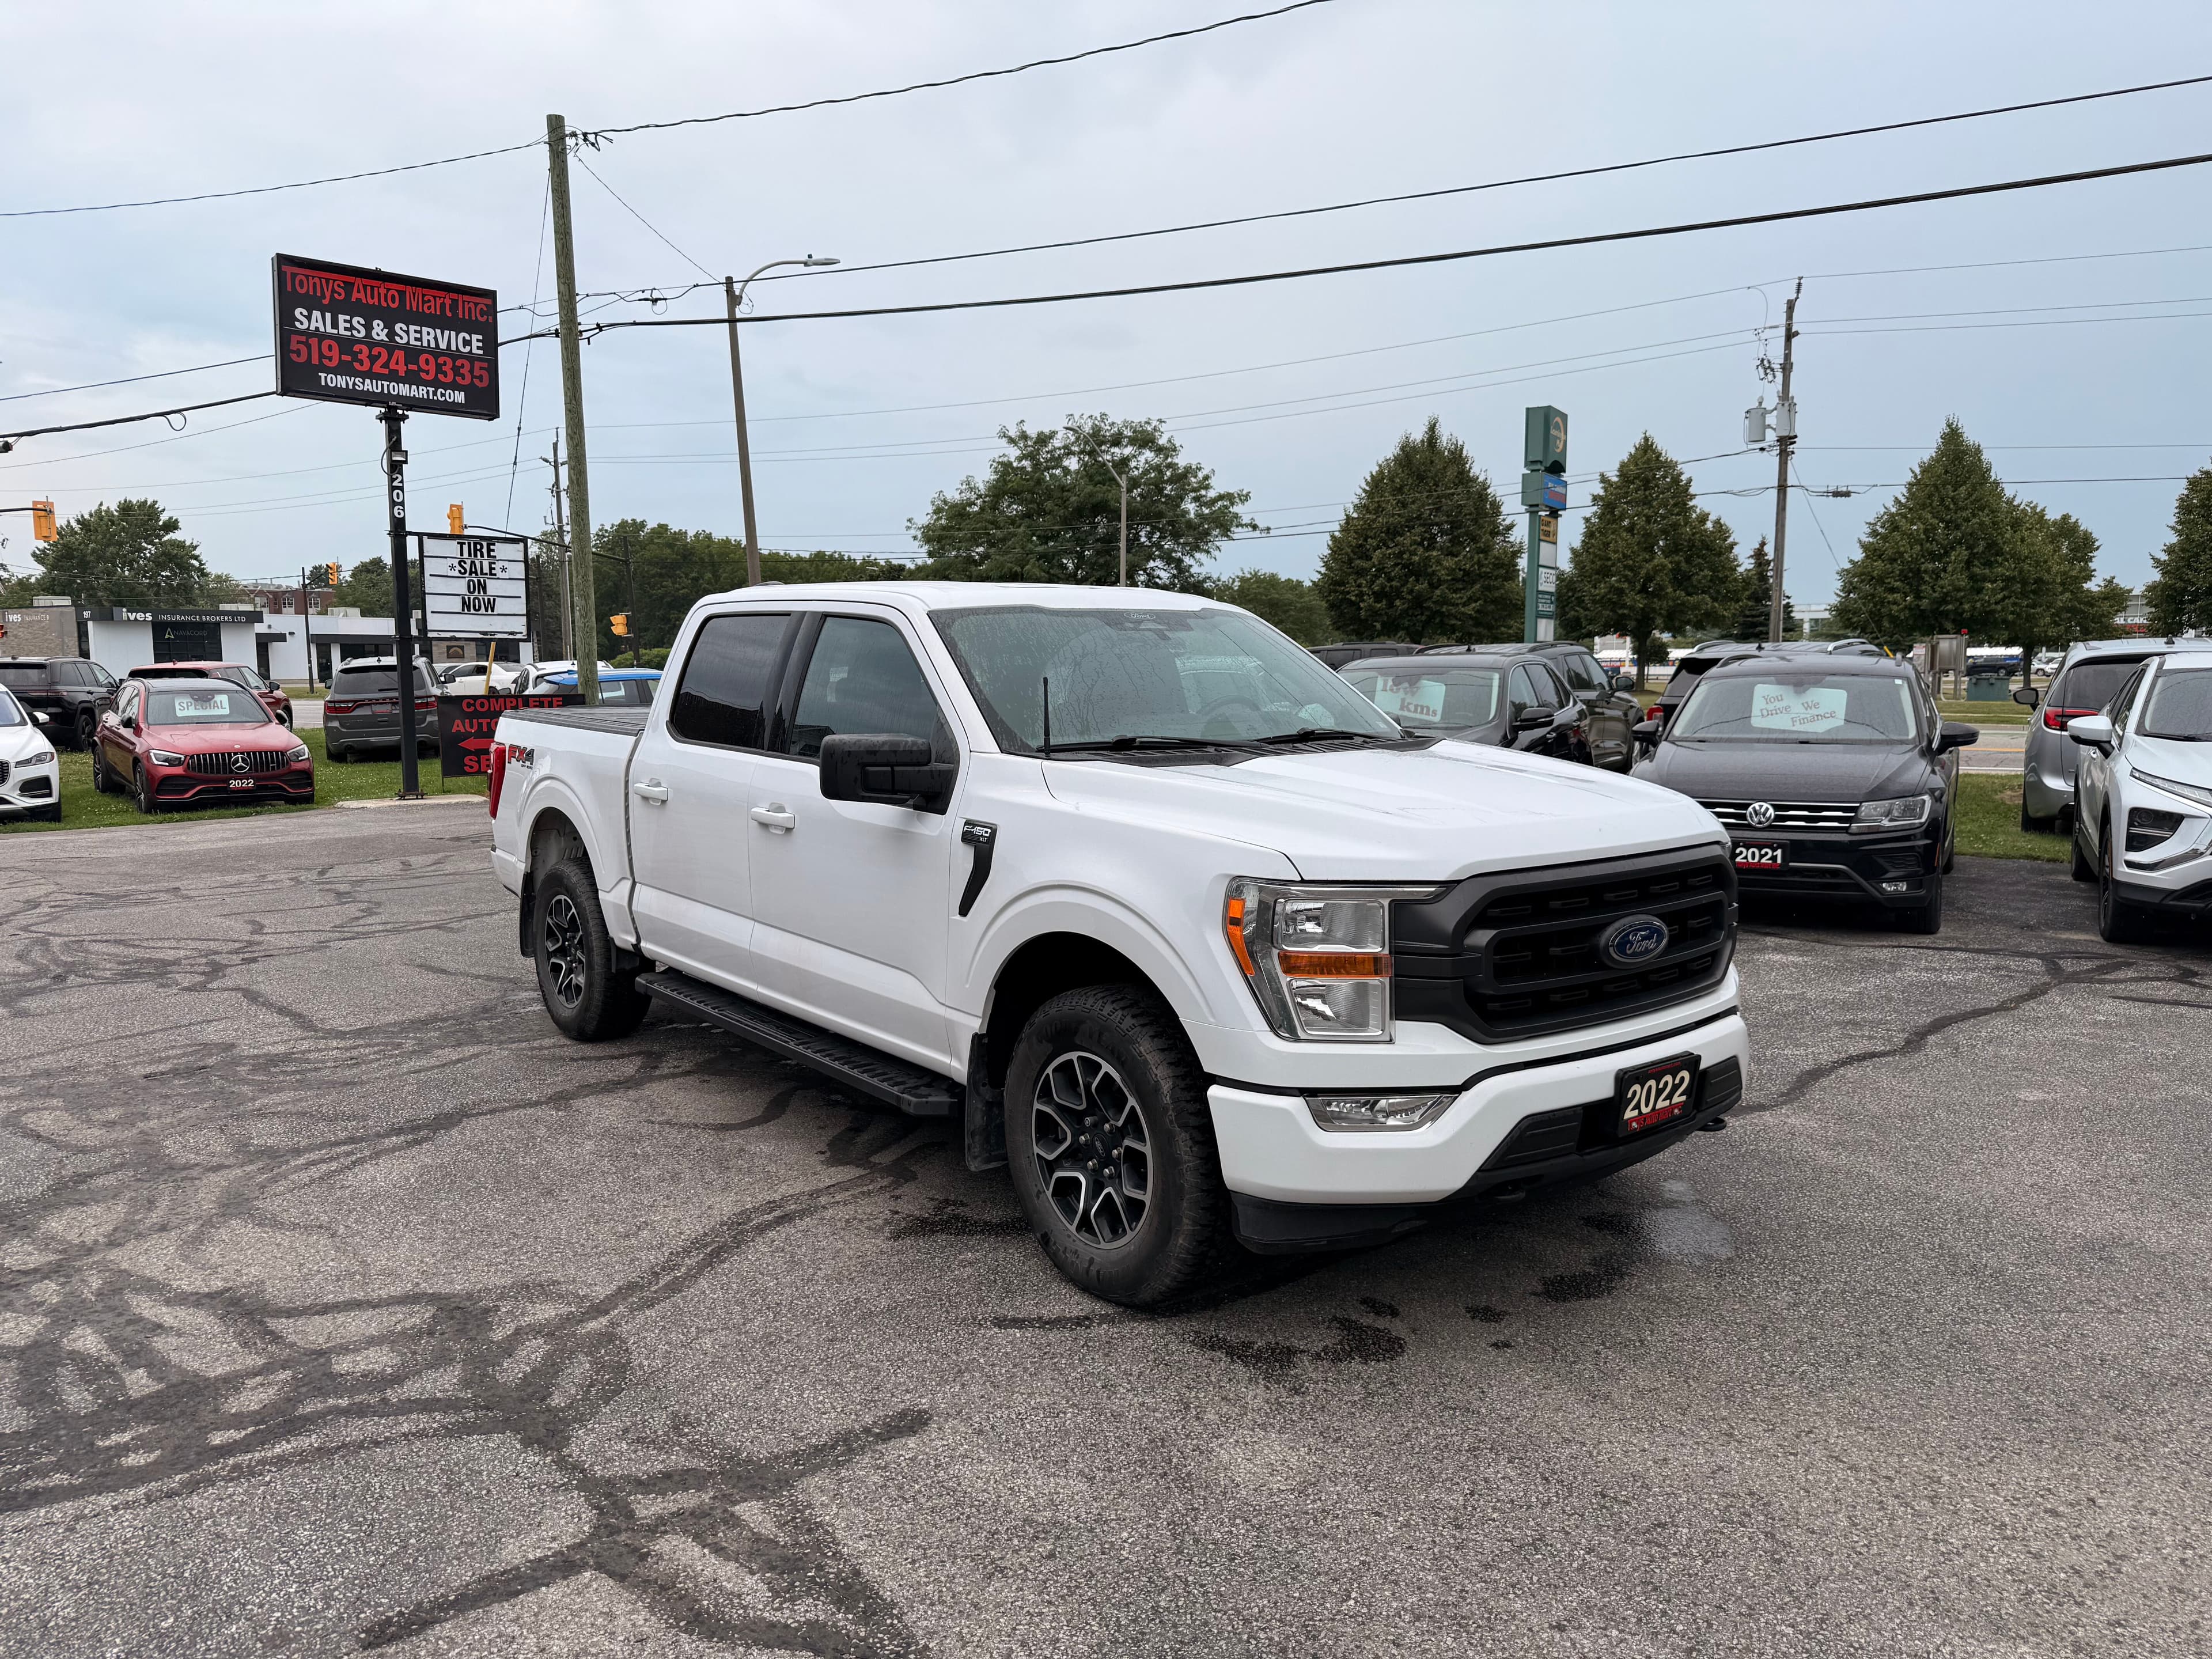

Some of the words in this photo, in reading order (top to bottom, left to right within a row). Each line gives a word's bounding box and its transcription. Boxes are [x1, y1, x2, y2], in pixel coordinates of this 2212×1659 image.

[282, 266, 346, 304] Tonys
[351, 277, 400, 309] Auto
[406, 285, 452, 317] Mart
[457, 294, 493, 322] Inc.
[294, 308, 366, 338] SALES
[372, 319, 389, 342] &
[395, 323, 483, 354] SERVICE
[290, 334, 489, 388] 519-324-9335
[319, 373, 465, 404] TONYSAUTOMART.COM
[392, 474, 404, 518] 206
[1541, 529, 1551, 538] TIGER
[457, 541, 497, 559] TIRE
[467, 579, 487, 594] ON
[461, 596, 496, 612] NOW
[5, 611, 21, 622] ives
[83, 611, 91, 619] 197
[122, 608, 153, 622] ives
[178, 700, 226, 711] SPECIAL
[462, 697, 563, 712] COMPLETE
[1762, 694, 1784, 704] You
[1801, 700, 1820, 711] We
[1399, 698, 1438, 718] kms
[1760, 704, 1792, 718] Drive
[1790, 710, 1836, 727] Finance
[507, 744, 535, 764] FX4
[229, 779, 254, 787] 2022
[1735, 847, 1782, 863] 2021
[1626, 930, 1657, 954] Ford
[1623, 1070, 1690, 1120] 2022
